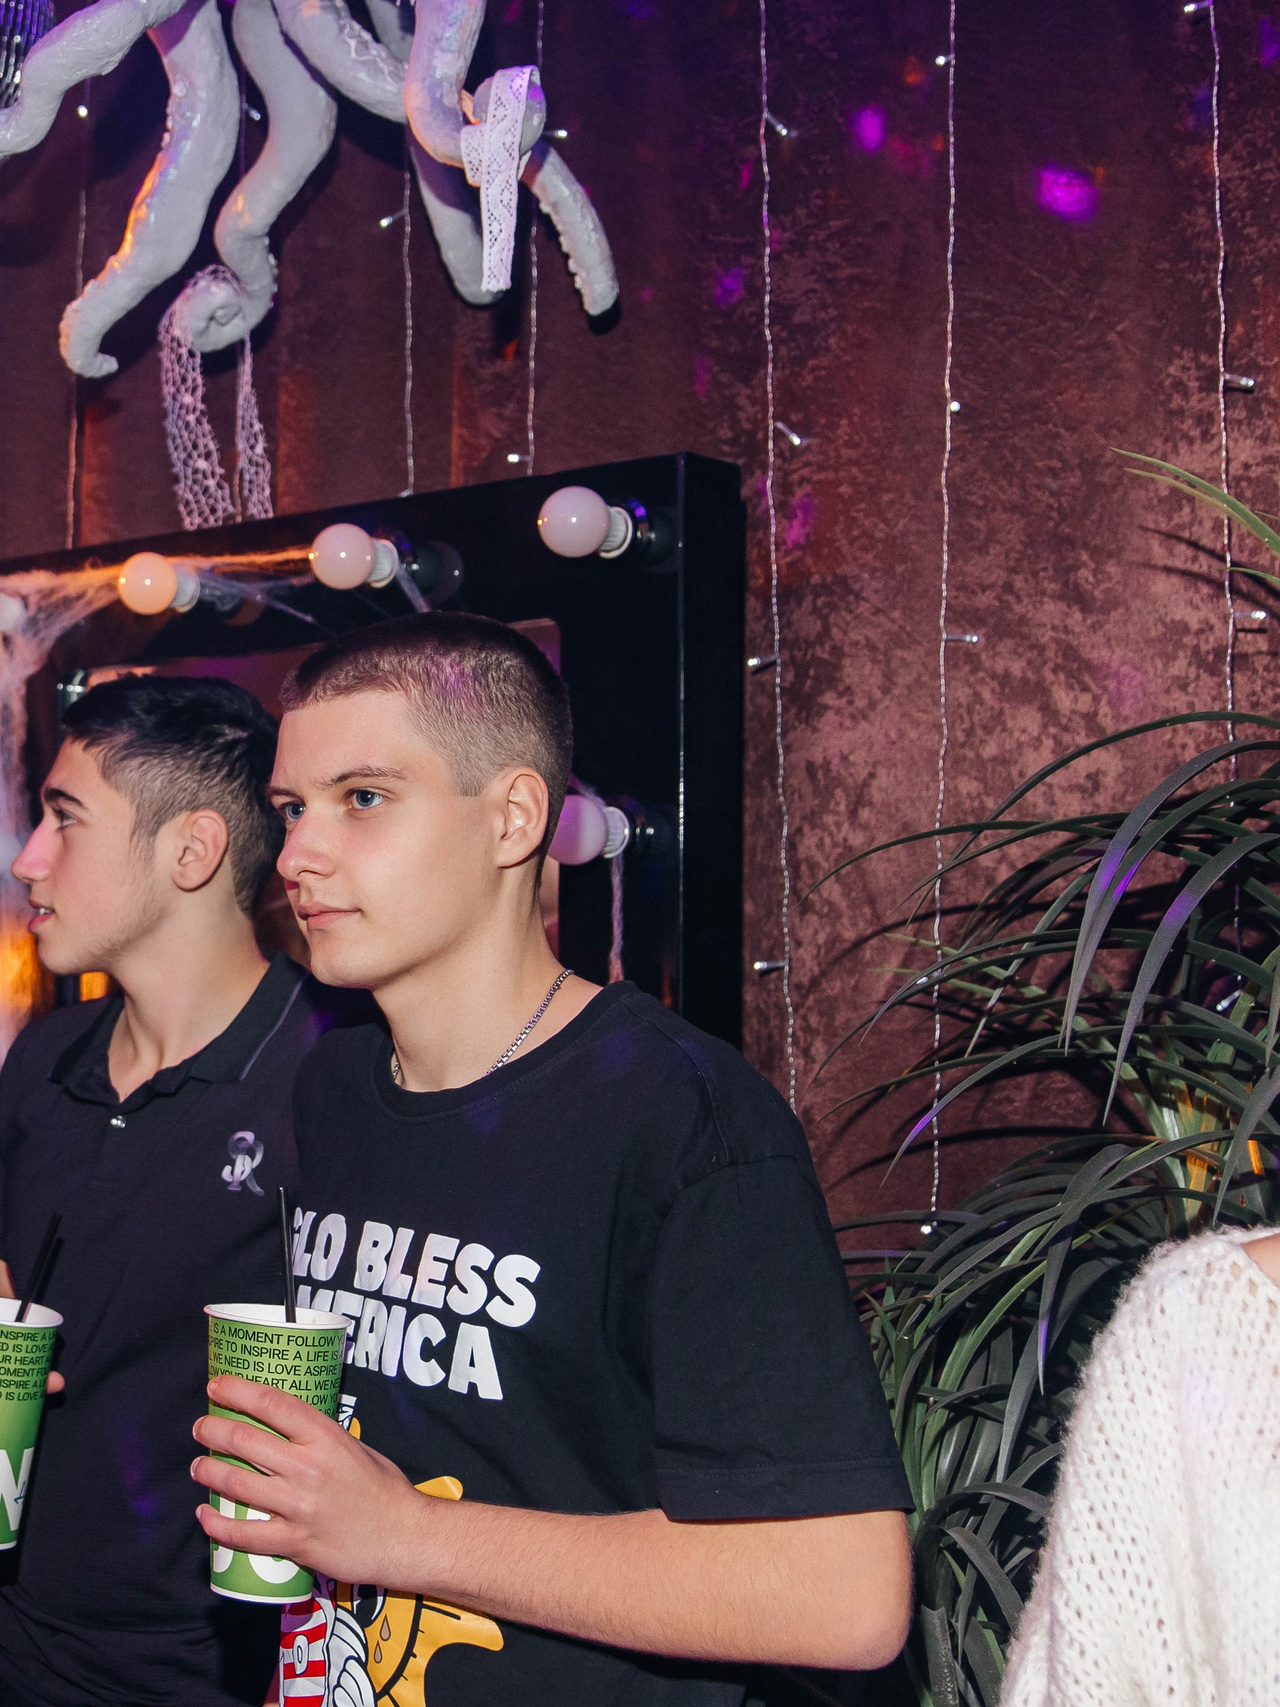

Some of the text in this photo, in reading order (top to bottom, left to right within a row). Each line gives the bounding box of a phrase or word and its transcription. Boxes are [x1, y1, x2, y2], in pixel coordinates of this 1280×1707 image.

[293, 1206, 542, 1328] LO BLESS
[40, 1332, 47, 1341] A
[220, 1324, 227, 1336] A
[228, 1325, 284, 1345] MOMENT
[287, 1334, 335, 1348] FOLLOW
[12, 1343, 23, 1353] IS
[25, 1344, 48, 1354] LOVE
[225, 1339, 238, 1353] TO
[240, 1343, 290, 1361] INSPIRE
[293, 1350, 303, 1361] A
[306, 1350, 330, 1362] LIFE
[331, 1349, 340, 1361] IS
[13, 1355, 45, 1366] HEART
[213, 1351, 223, 1365] WE
[225, 1354, 251, 1370] NEED
[253, 1360, 265, 1373] IS
[267, 1362, 302, 1376] LOVE
[303, 1364, 338, 1377] ASPIRE
[32, 1381, 38, 1389] A
[245, 1373, 288, 1390] HEART
[289, 1379, 312, 1391] ALL
[314, 1379, 329, 1391] WE
[5, 1391, 16, 1401] IS
[17, 1392, 39, 1402] LOVE
